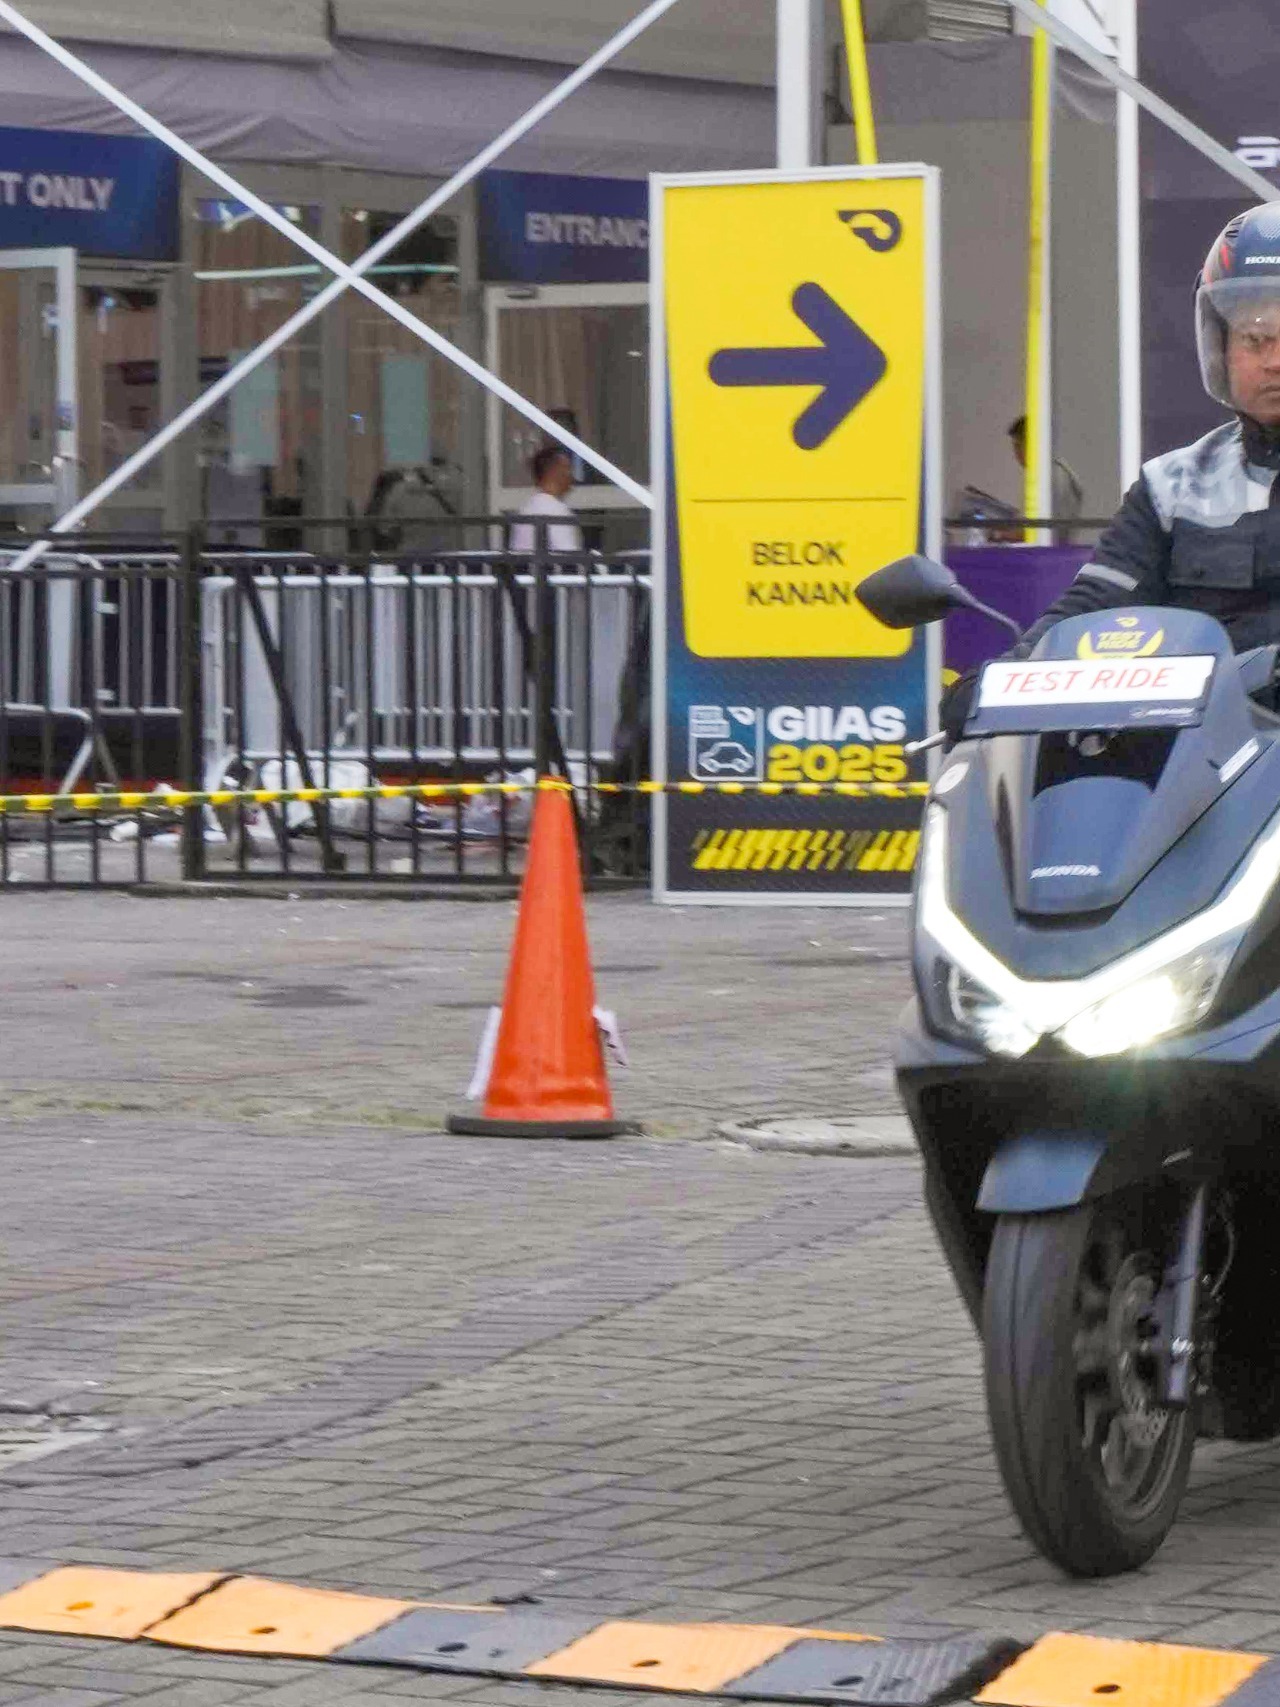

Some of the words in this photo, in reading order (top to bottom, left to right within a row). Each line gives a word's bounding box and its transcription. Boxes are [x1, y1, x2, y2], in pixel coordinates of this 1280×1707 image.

[27, 173, 115, 211] ONLY
[752, 541, 847, 566] BELOK
[746, 581, 851, 606] KANAN
[1001, 669, 1085, 694] TEST
[1090, 666, 1175, 690] RIDE
[767, 705, 907, 742] GIIAS
[767, 744, 908, 782] 2025
[1029, 864, 1102, 880] HONDA
